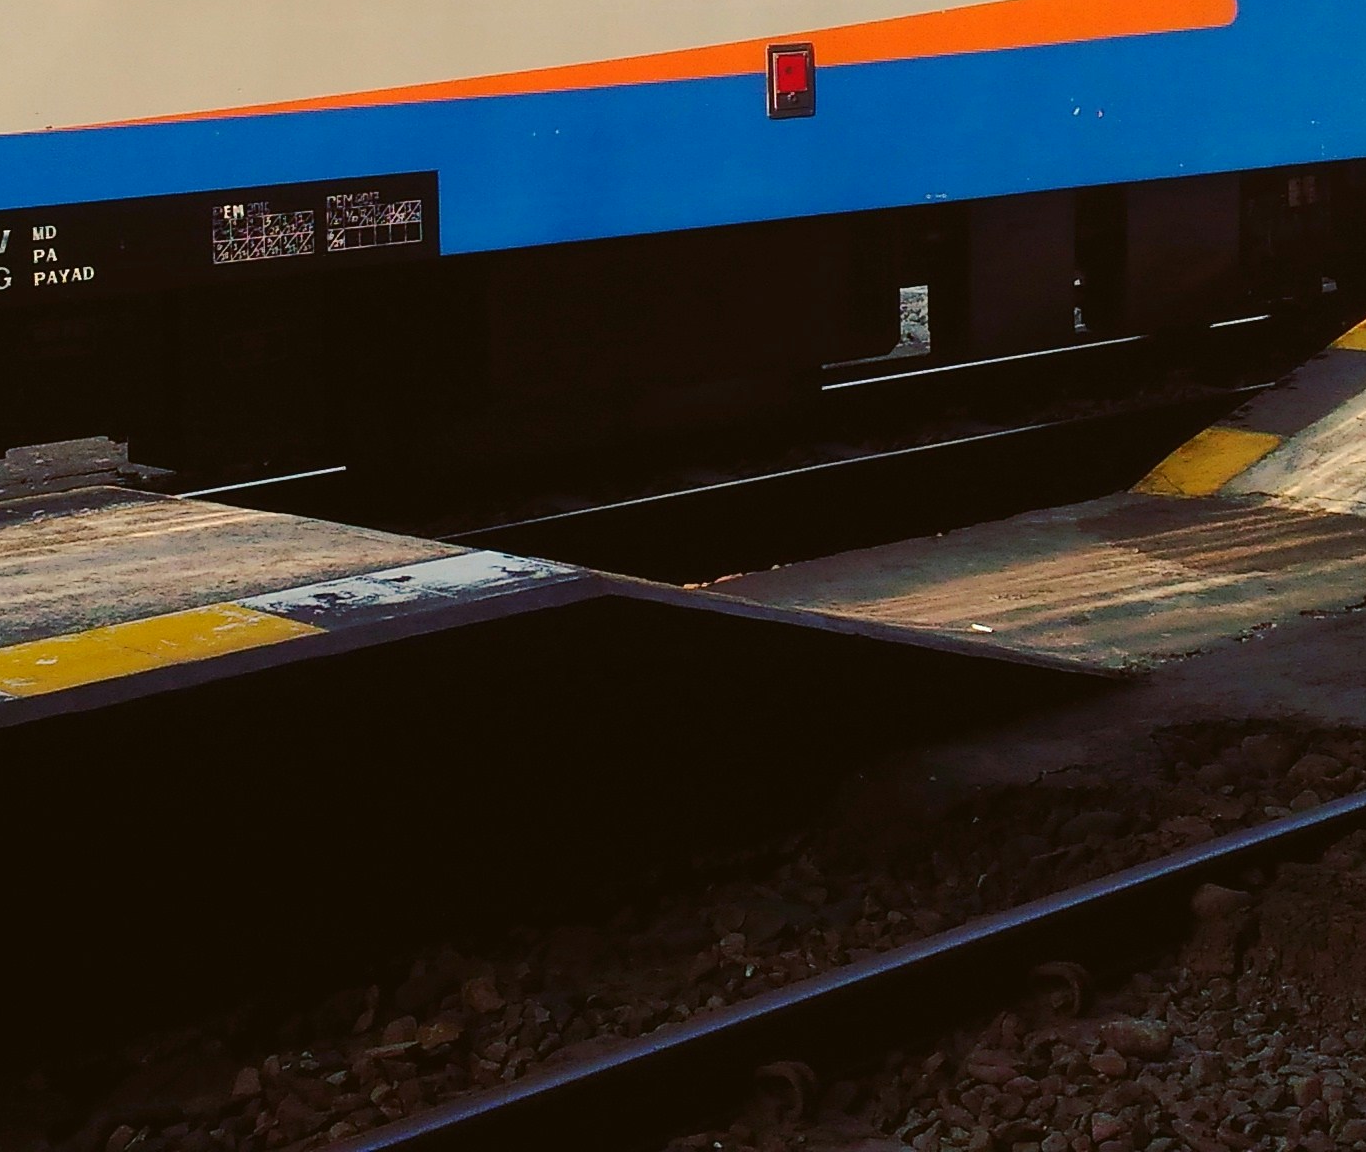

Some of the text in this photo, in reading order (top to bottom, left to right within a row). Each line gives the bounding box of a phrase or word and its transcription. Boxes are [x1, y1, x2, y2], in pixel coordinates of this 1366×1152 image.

[32, 225, 57, 242] MD
[33, 249, 58, 264] PA
[33, 266, 95, 287] PAYAD
